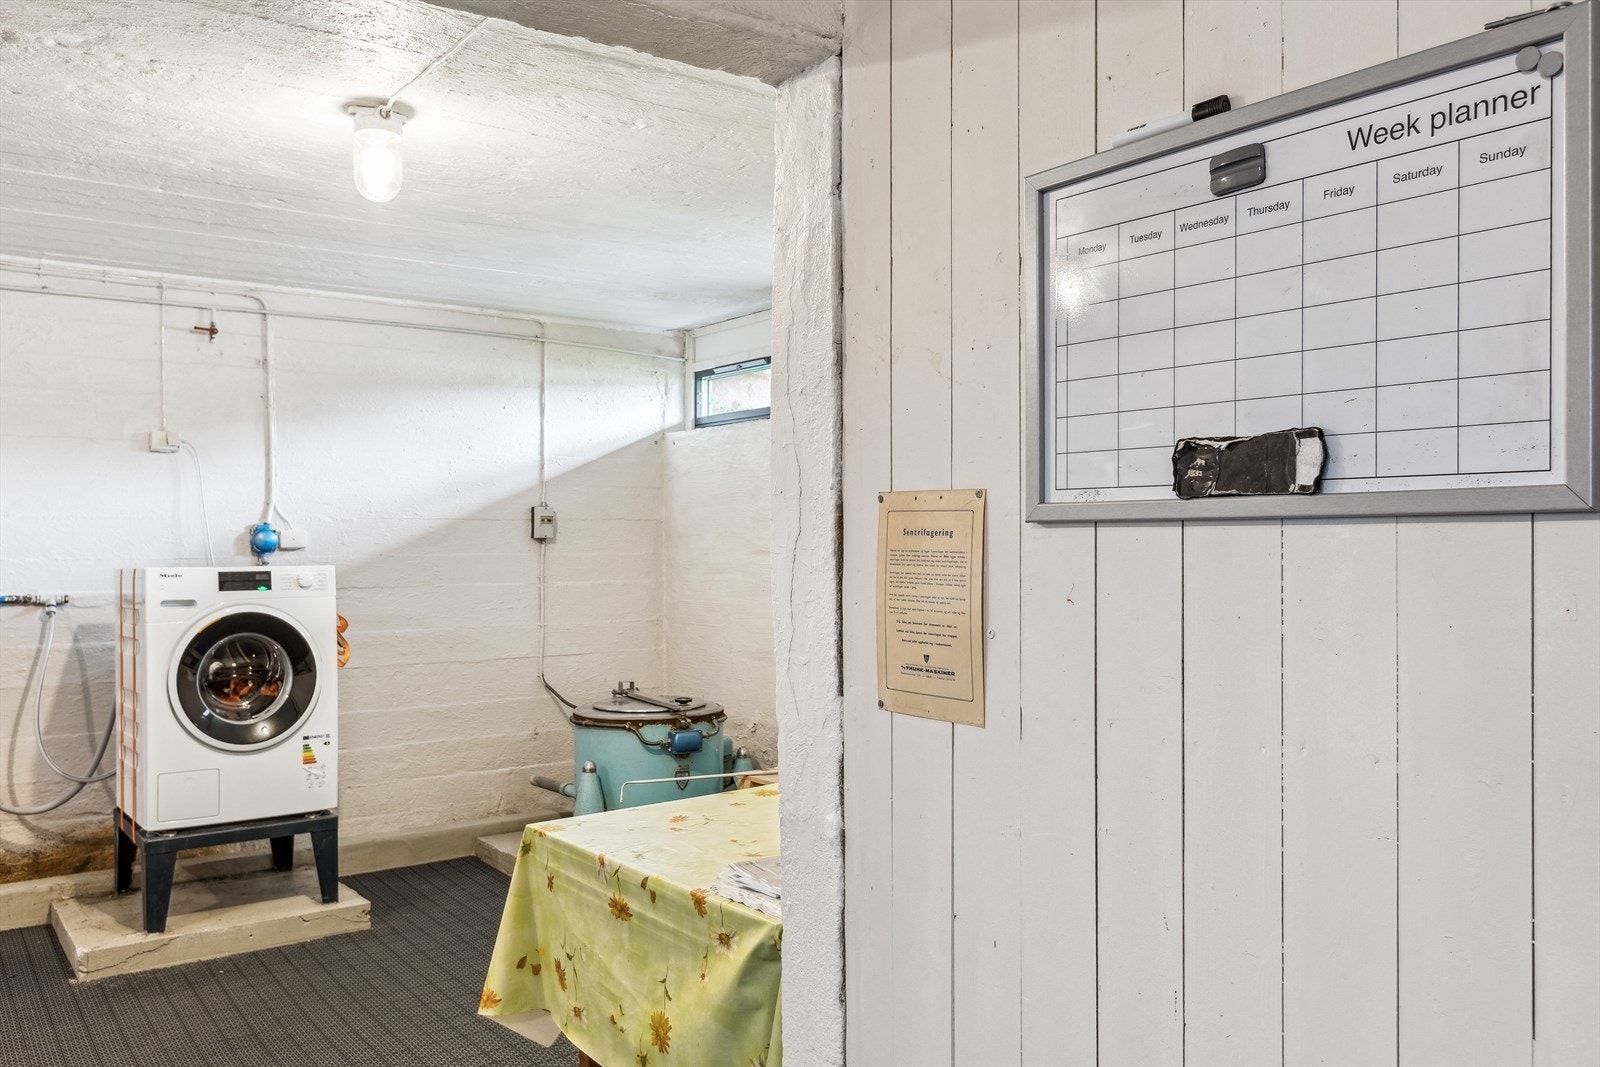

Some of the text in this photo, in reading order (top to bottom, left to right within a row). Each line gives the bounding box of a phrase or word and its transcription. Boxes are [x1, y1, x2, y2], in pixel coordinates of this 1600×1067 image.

[1346, 83, 1541, 151] Week planner
[1077, 145, 1527, 256] Monday Tuesday Wednesday Thursday Friday Saturday Sunday
[903, 528, 954, 539] Sentrifugering
